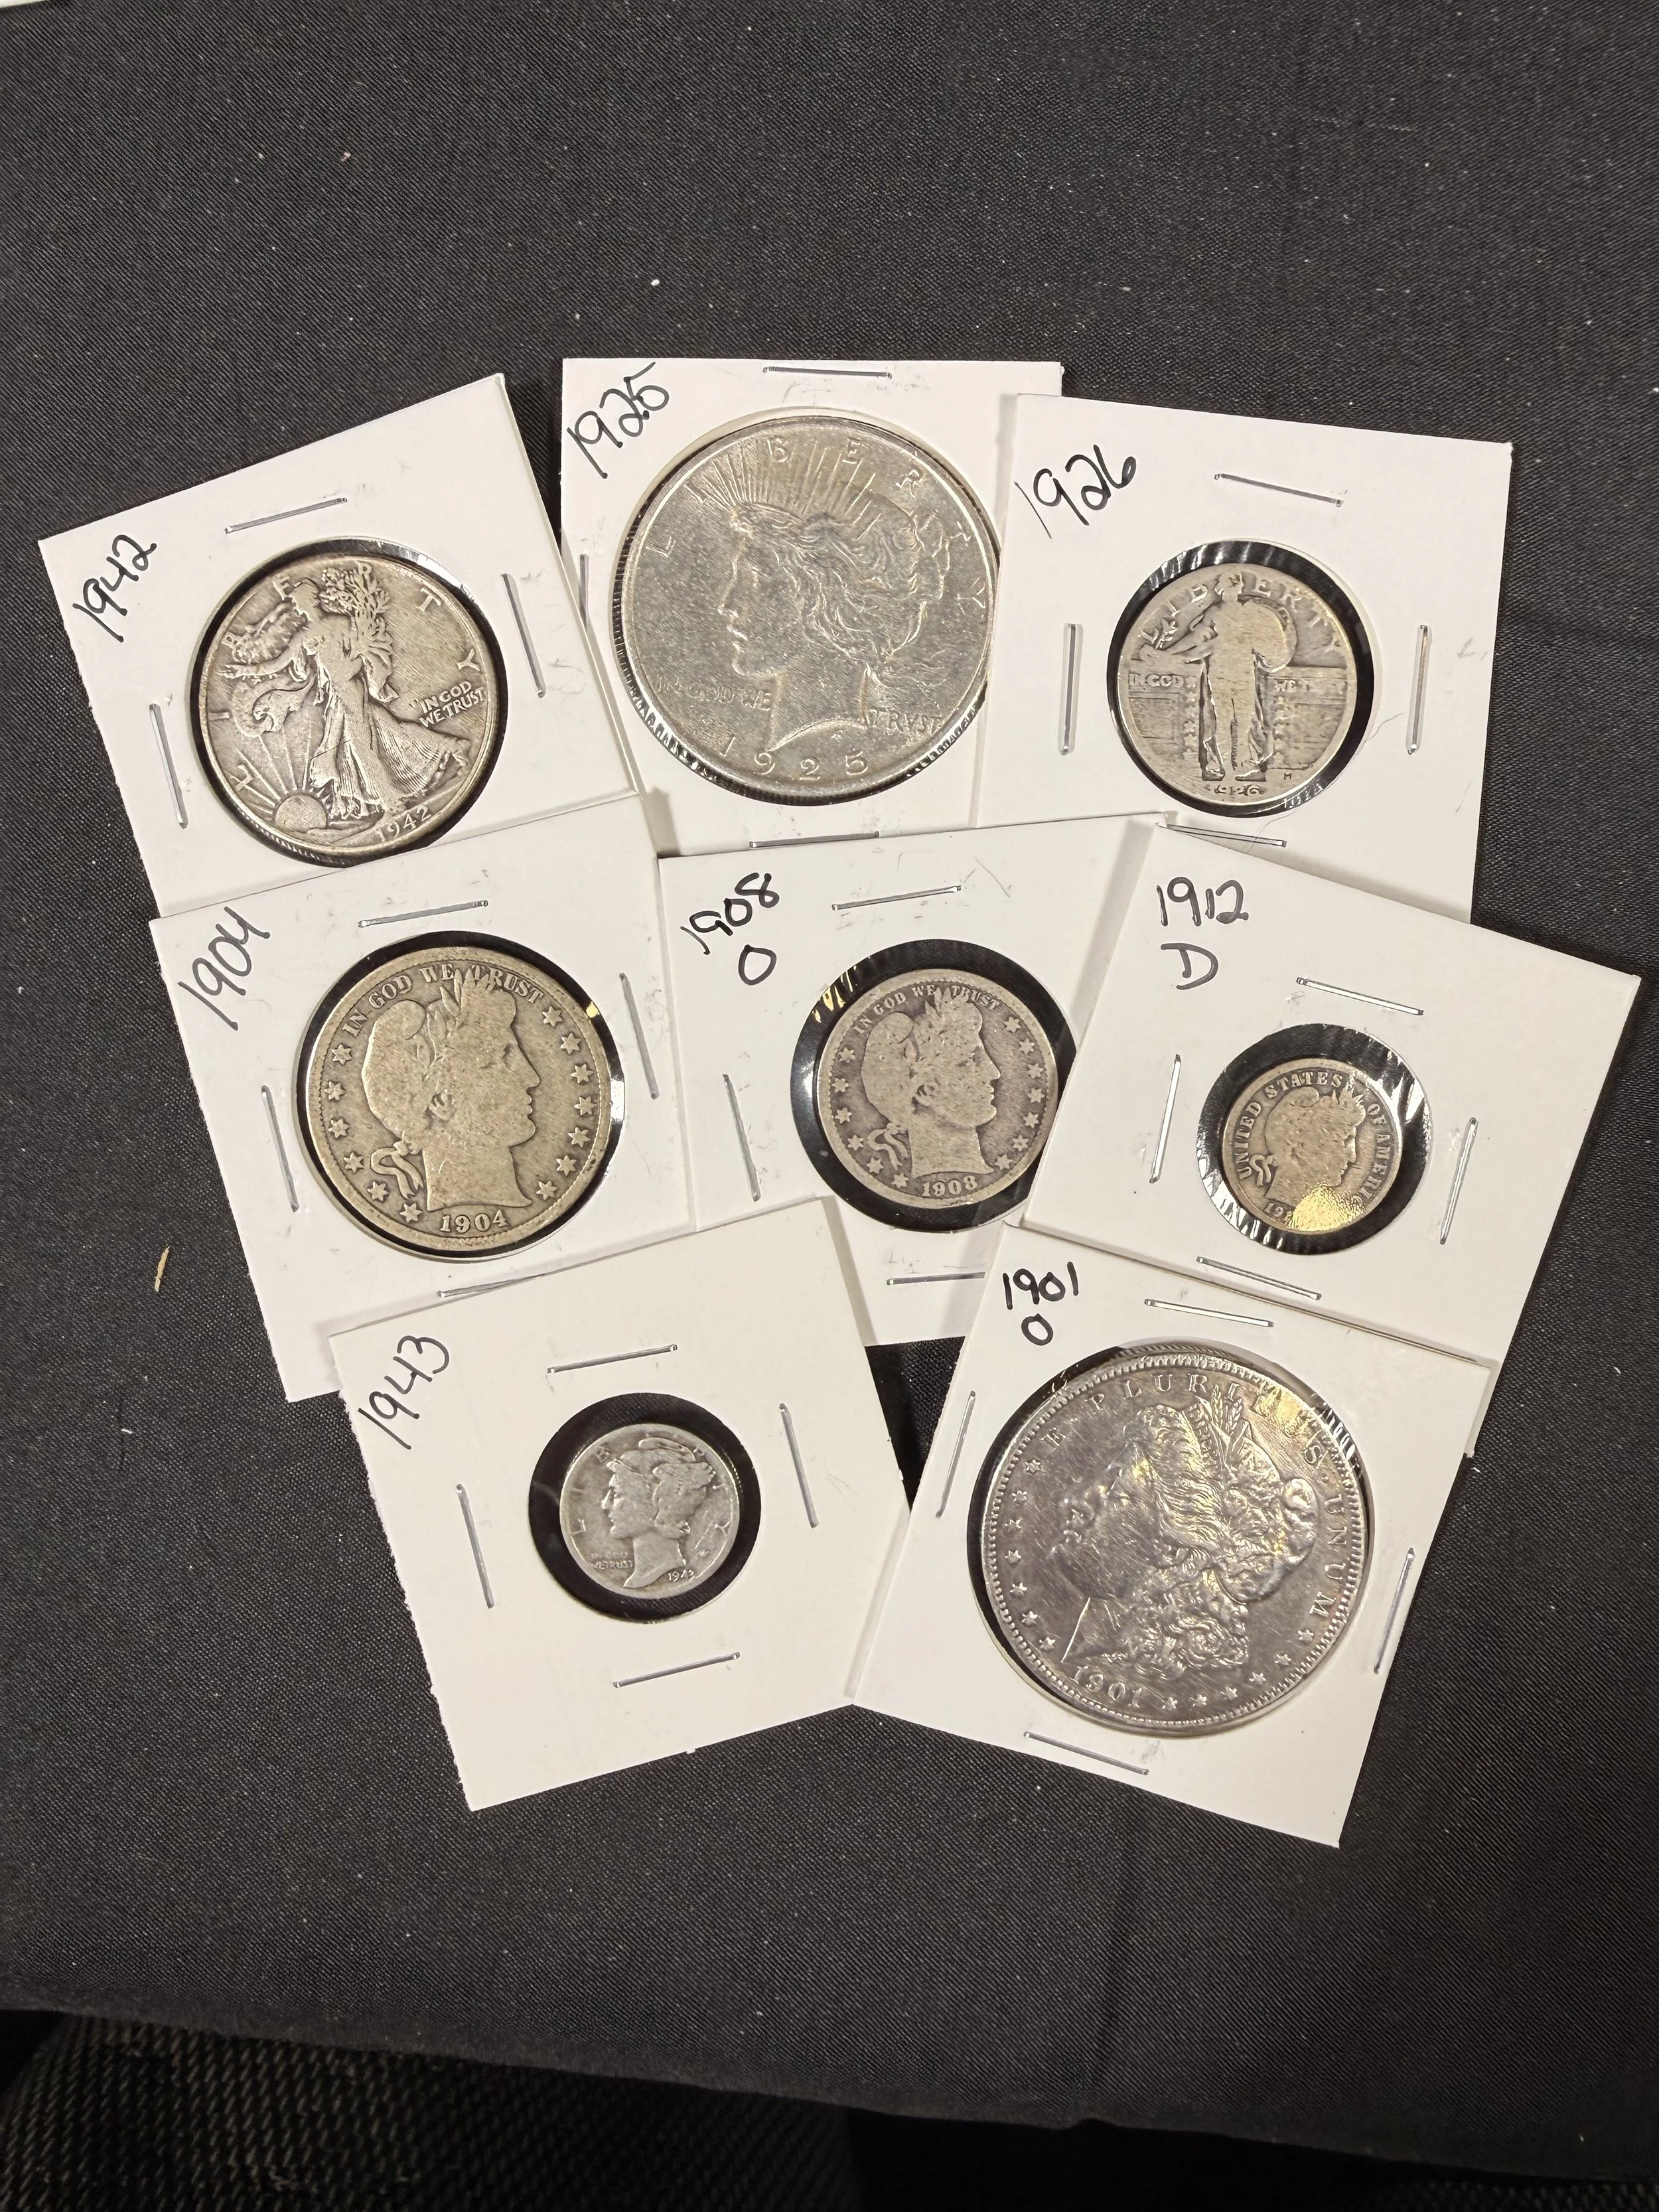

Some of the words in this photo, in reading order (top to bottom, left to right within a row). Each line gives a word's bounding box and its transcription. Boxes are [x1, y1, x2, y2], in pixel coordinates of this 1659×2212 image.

[567, 362, 670, 479] 1925
[1014, 444, 1137, 539] 1926
[72, 534, 157, 643] 1942
[419, 698, 440, 713] IN
[440, 680, 472, 703] GOD
[419, 710, 445, 728] WE
[445, 686, 484, 717] TRUST
[719, 735, 869, 782] 1925
[376, 804, 431, 842] 1942
[680, 872, 780, 955] 1908
[1156, 877, 1249, 926] 1912
[177, 907, 271, 1031] 1904
[1161, 942, 1218, 990] D
[342, 1009, 369, 1038] IN
[368, 974, 413, 1009] GOD
[419, 963, 455, 983] WE
[471, 964, 543, 1004] TRUST
[853, 1014, 873, 1035] IN
[873, 992, 906, 1015] GOD
[911, 984, 936, 997] WE
[952, 984, 1001, 1011] TRUST
[1234, 1101, 1262, 1180] UNITED
[1264, 1072, 1343, 1099] STATES
[1367, 1102, 1386, 1125] OF
[921, 1175, 978, 1197] 1908
[439, 1210, 508, 1233] 1904
[1002, 1261, 1079, 1310] 1901
[358, 1335, 449, 1450] 1943
[1309, 1496, 1346, 1621] UNUM
[1068, 1665, 1143, 1708] 1901
